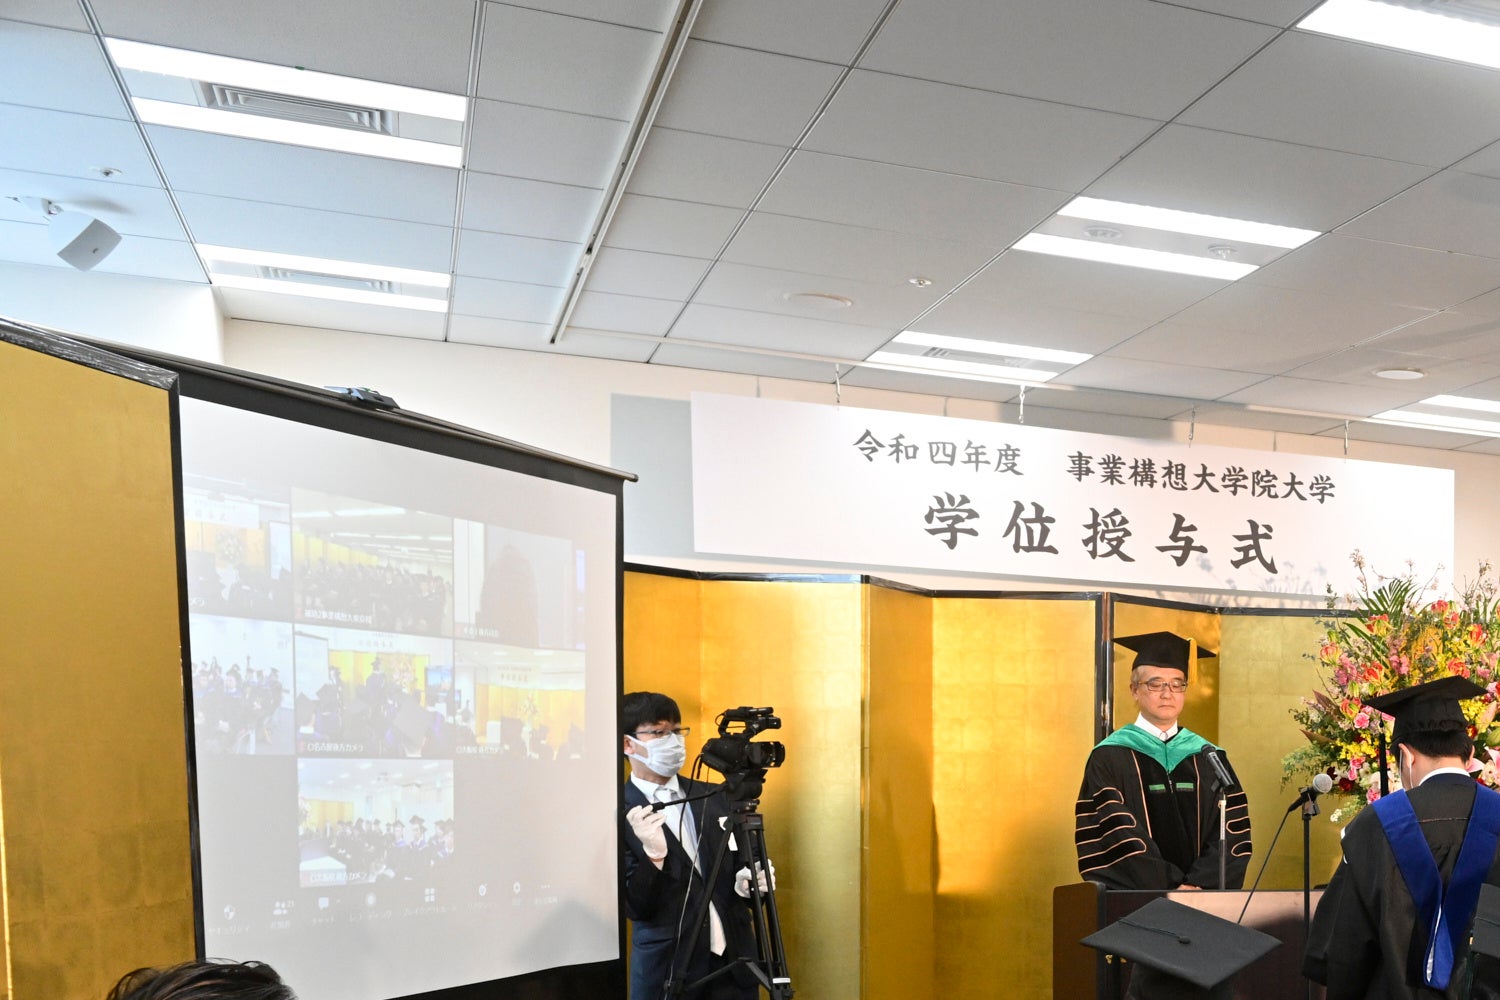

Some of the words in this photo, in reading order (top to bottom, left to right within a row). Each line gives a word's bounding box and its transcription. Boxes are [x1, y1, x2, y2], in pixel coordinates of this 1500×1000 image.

[853, 429, 1024, 476] 令和四年度
[1066, 450, 1336, 505] 事業構想大学院大学
[924, 492, 1278, 575] 学位授与式
